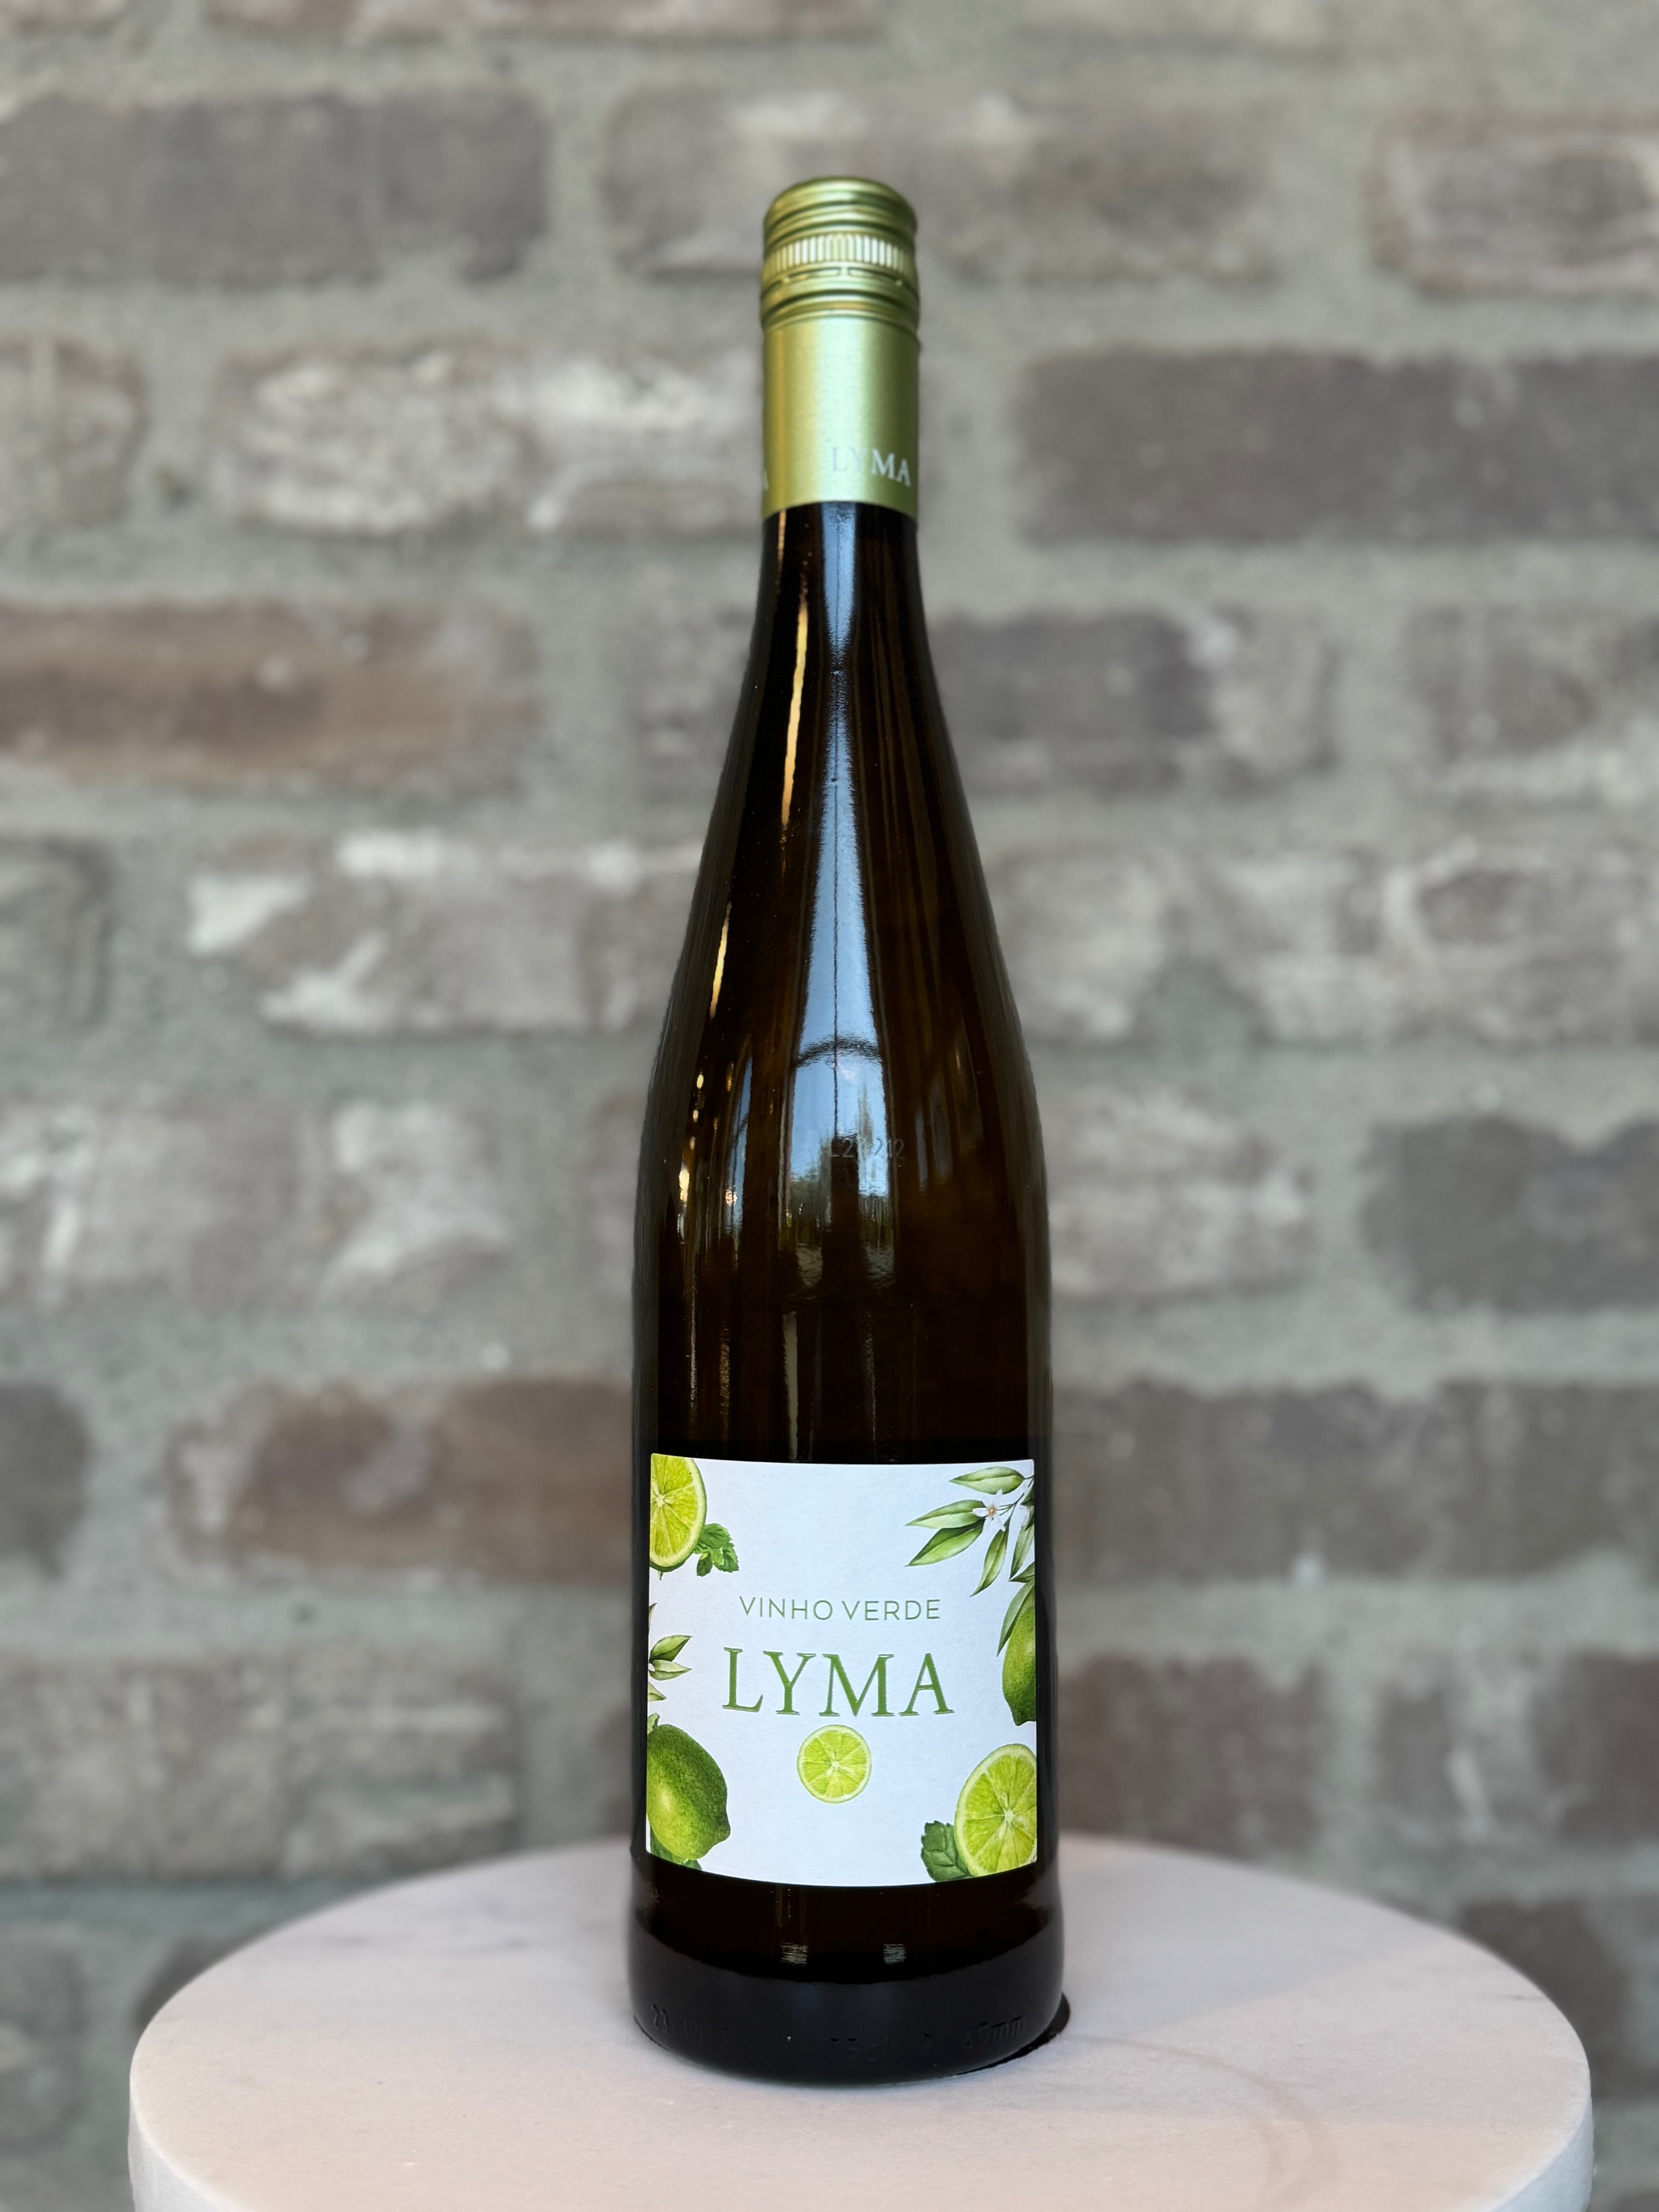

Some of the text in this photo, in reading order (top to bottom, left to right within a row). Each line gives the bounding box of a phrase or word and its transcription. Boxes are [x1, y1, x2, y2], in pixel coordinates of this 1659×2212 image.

[831, 447, 911, 487] LYMA
[739, 1596, 940, 1621] VINHO VERDE
[722, 1647, 955, 1717] LYMA
